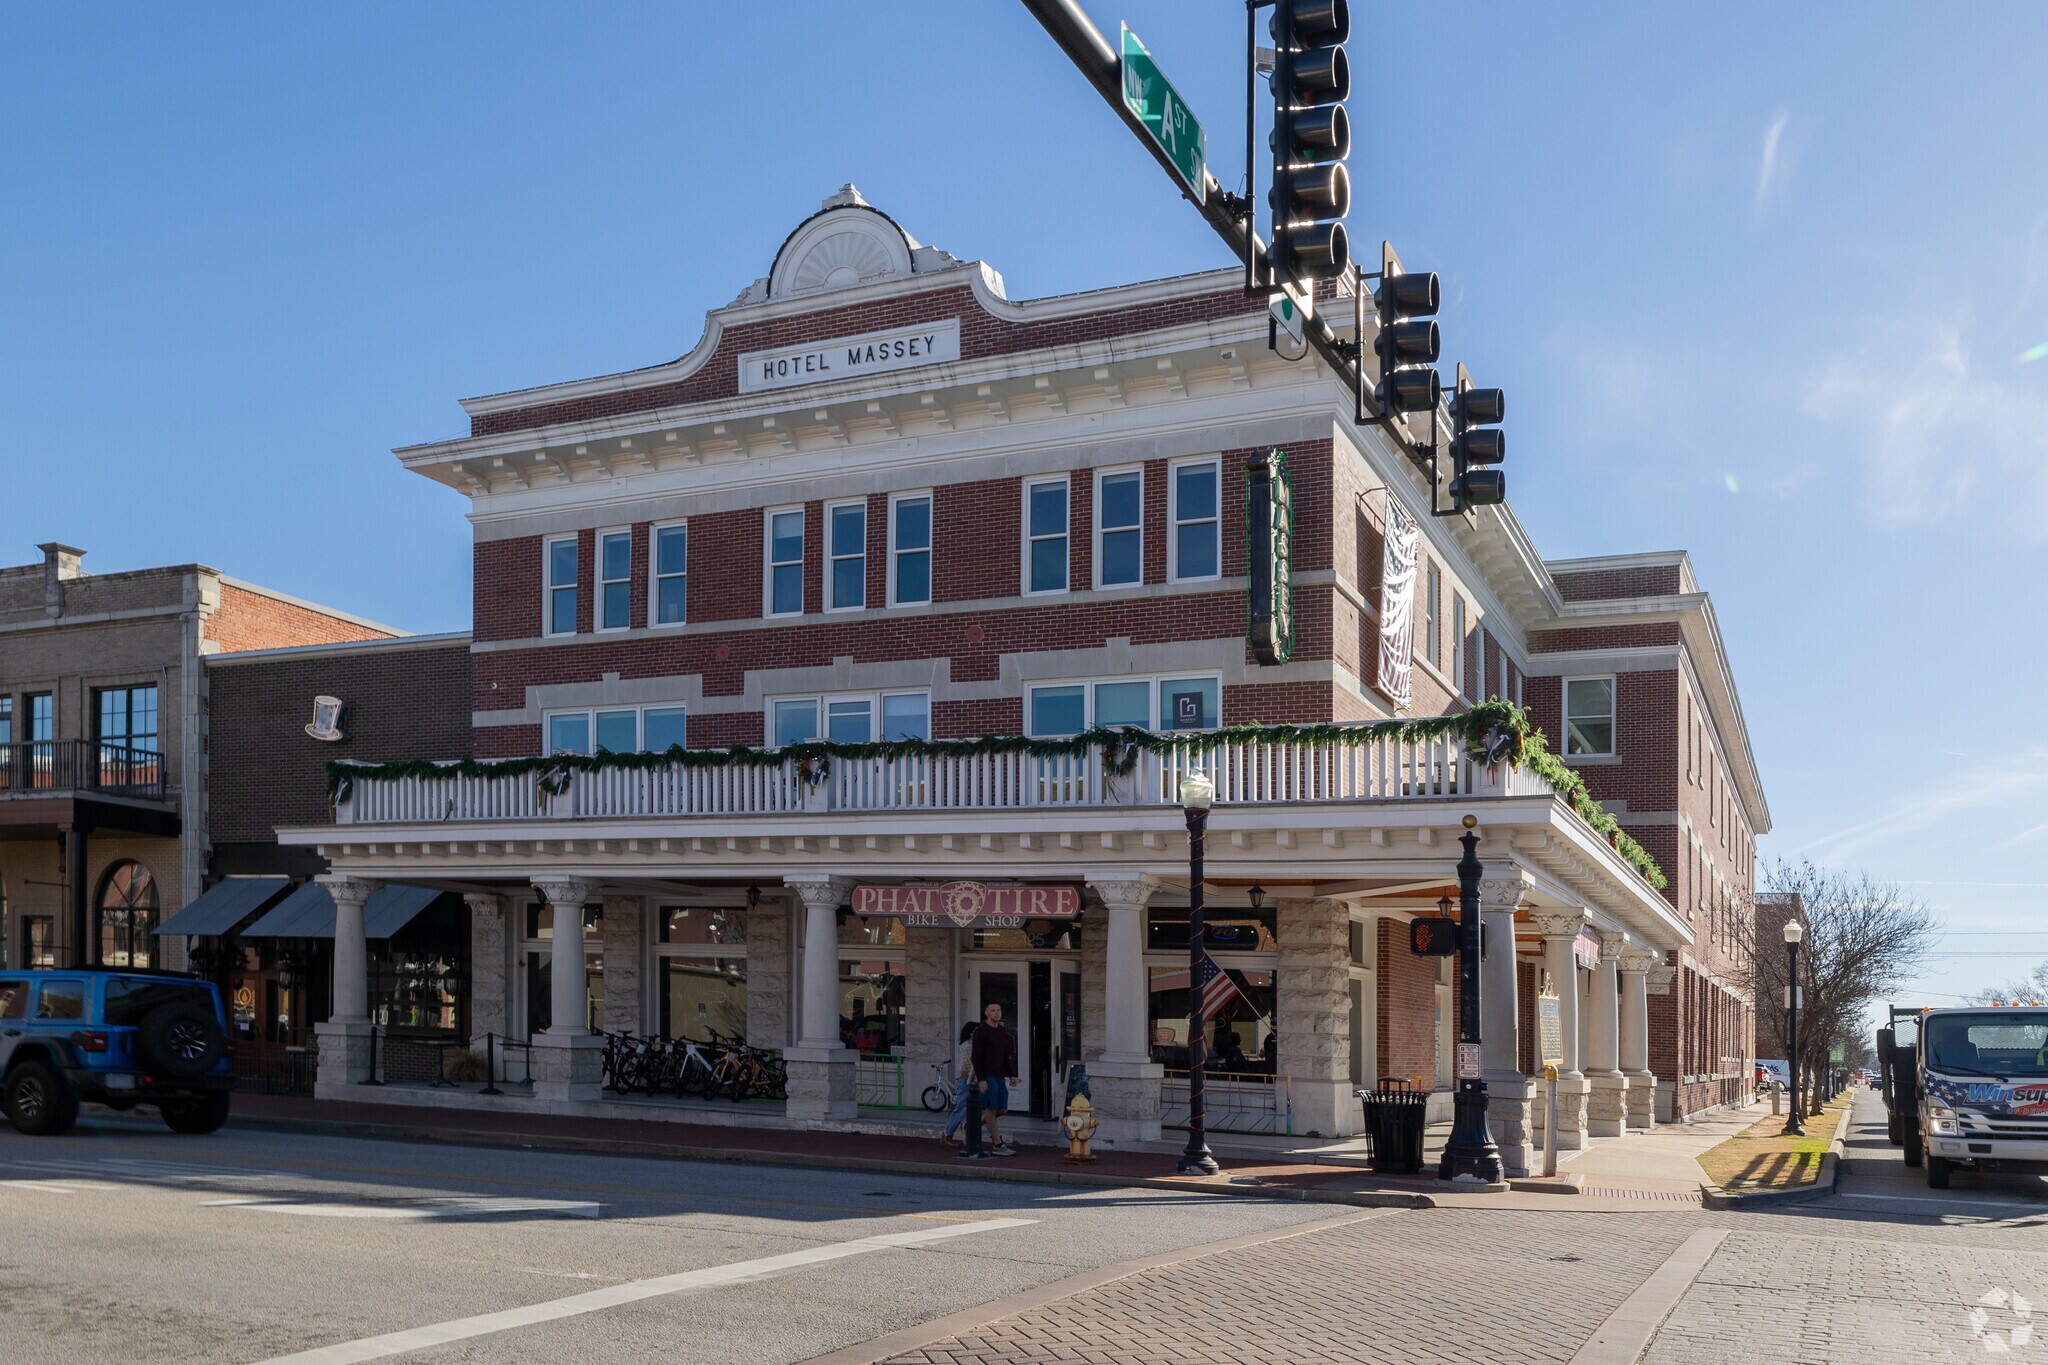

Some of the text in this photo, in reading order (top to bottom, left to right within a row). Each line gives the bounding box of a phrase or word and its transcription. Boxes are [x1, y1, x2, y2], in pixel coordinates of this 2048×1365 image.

[1128, 63, 1142, 106] NW
[1161, 90, 1177, 155] A
[1174, 102, 1188, 136] ST
[763, 334, 935, 380] HOTEL MASSEY
[858, 887, 1075, 915] PHAT TIRE
[907, 914, 1020, 927] BIKE SHOP
[2006, 1107, 2020, 1115] OF
